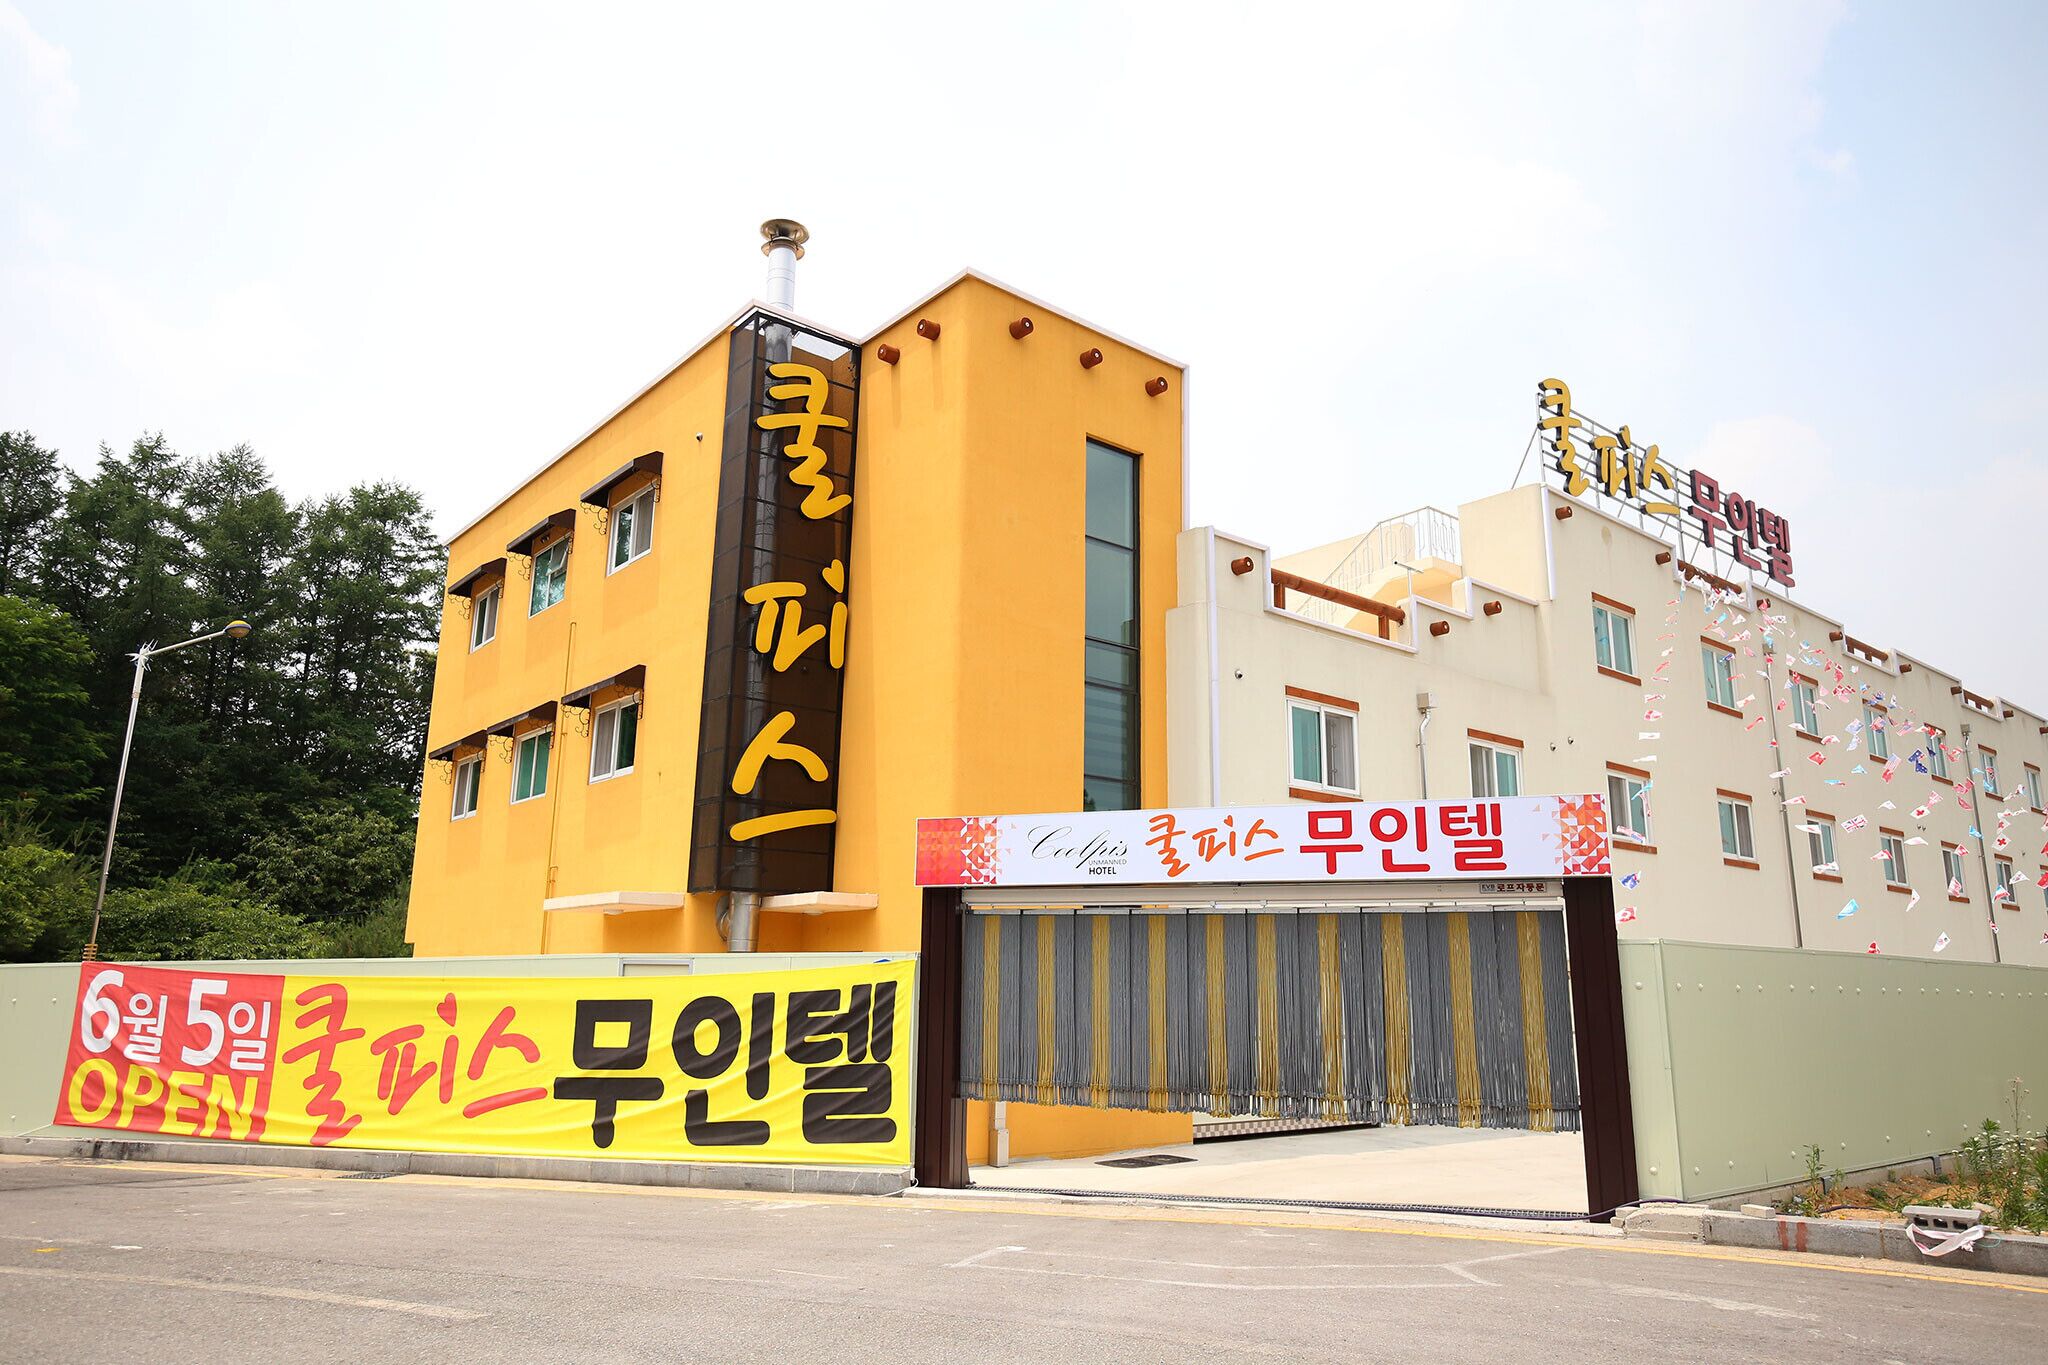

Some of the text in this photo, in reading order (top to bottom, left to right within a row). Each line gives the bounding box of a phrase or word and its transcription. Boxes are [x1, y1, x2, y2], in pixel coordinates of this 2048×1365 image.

[1537, 378, 1795, 588] 쿨피스 무인텔
[729, 363, 852, 842] 쿨피스
[1027, 825, 1128, 869] Coolpis
[1088, 866, 1117, 876] HOTEL
[1145, 803, 1507, 877] 쿨피스 무인텔
[80, 969, 271, 1072] 6월 5일
[282, 980, 898, 1149] 쿨피스 무인텔
[68, 1058, 258, 1141] OPEN
